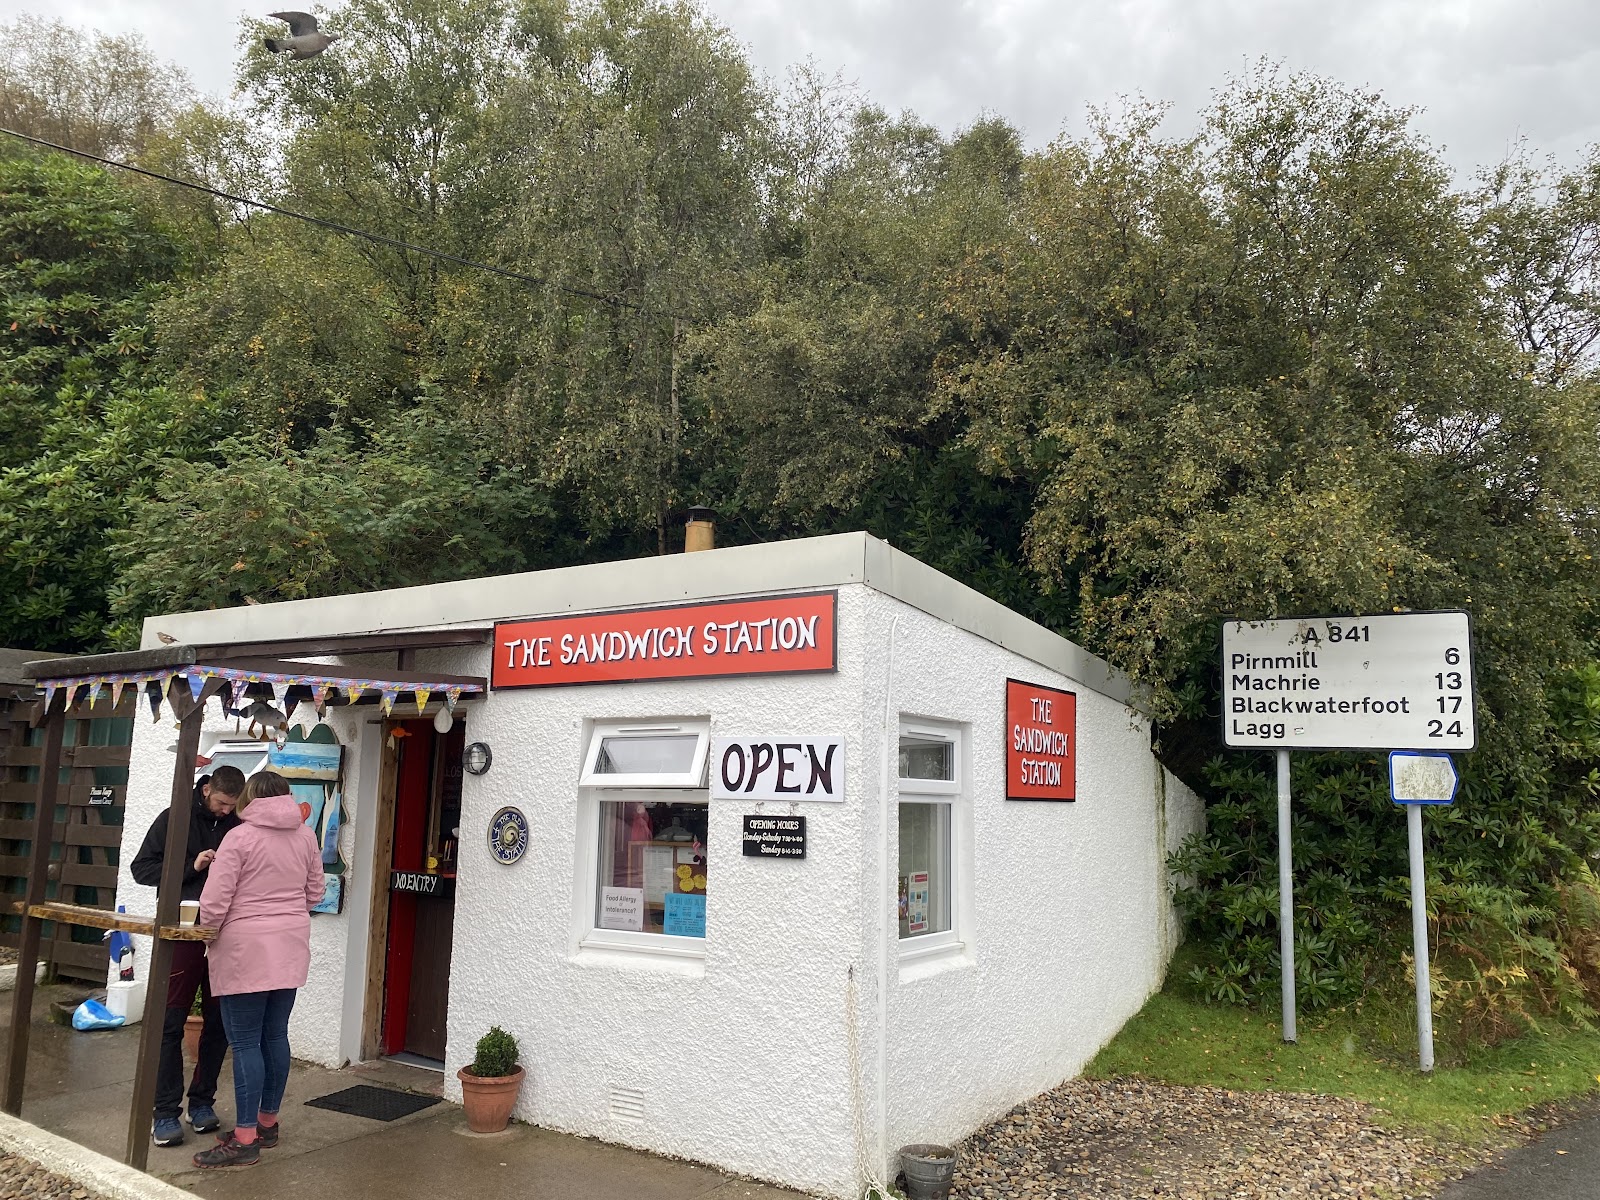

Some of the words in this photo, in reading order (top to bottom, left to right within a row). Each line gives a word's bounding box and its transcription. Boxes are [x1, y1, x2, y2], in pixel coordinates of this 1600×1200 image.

[504, 637, 552, 668] THE
[560, 624, 695, 664] SANDWICH
[703, 615, 819, 655] STATION
[1303, 627, 1319, 644] A
[1328, 625, 1370, 643] 841
[1231, 651, 1318, 670] Pirnmill
[1445, 647, 1460, 666] 6
[1232, 673, 1321, 691] Machrie
[1434, 672, 1463, 690] 13
[1030, 697, 1052, 724] THE
[1232, 696, 1410, 714] Blackwaterfoot
[1436, 696, 1463, 714] 17
[1233, 719, 1286, 739] Lagg
[1427, 720, 1464, 738] 24
[1014, 724, 1069, 757] SANDWICH
[721, 742, 839, 794] OPEN
[1021, 757, 1062, 787] STATION
[498, 813, 510, 824] THE
[511, 813, 522, 825] OLD
[749, 819, 776, 829] OPENING
[776, 820, 800, 830] HOURS
[761, 844, 781, 857] Sunday
[395, 872, 407, 889] NO
[405, 874, 437, 892] ENTRY
[605, 894, 618, 902] Food
[619, 895, 637, 904] Allergy
[605, 906, 637, 915] Intolerance?
